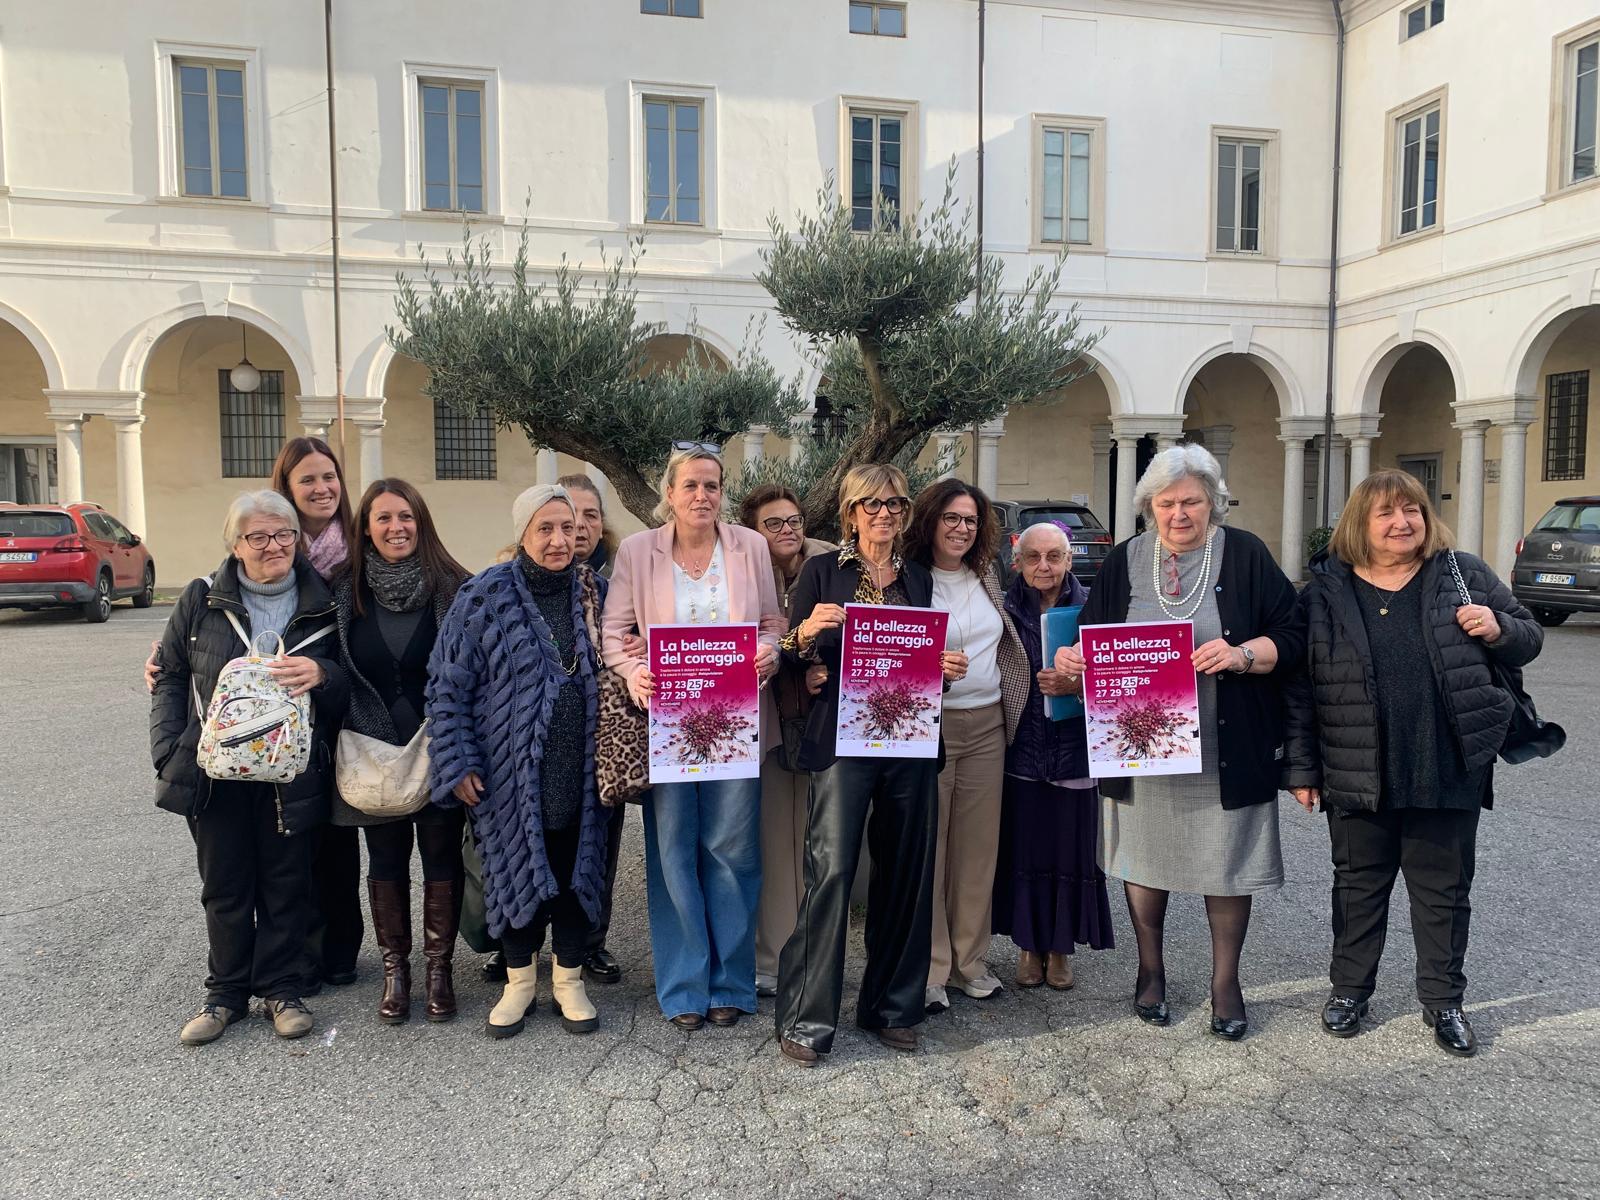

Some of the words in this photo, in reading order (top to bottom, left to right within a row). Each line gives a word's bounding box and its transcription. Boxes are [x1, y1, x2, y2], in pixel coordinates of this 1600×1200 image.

[854, 619, 870, 630] La
[874, 620, 926, 633] bellezza
[660, 640, 676, 652] La
[681, 639, 736, 651] bellezza
[853, 632, 873, 643] del
[876, 634, 934, 648] coraggio
[1092, 640, 1109, 651] La
[1114, 637, 1170, 650] bellezza
[660, 653, 680, 664] del
[684, 651, 745, 666] coraggio
[1093, 652, 1114, 664] del
[1118, 648, 1180, 664] coraggio
[878, 660, 890, 668] 25
[689, 681, 701, 689] 25
[1124, 678, 1136, 686] 25
